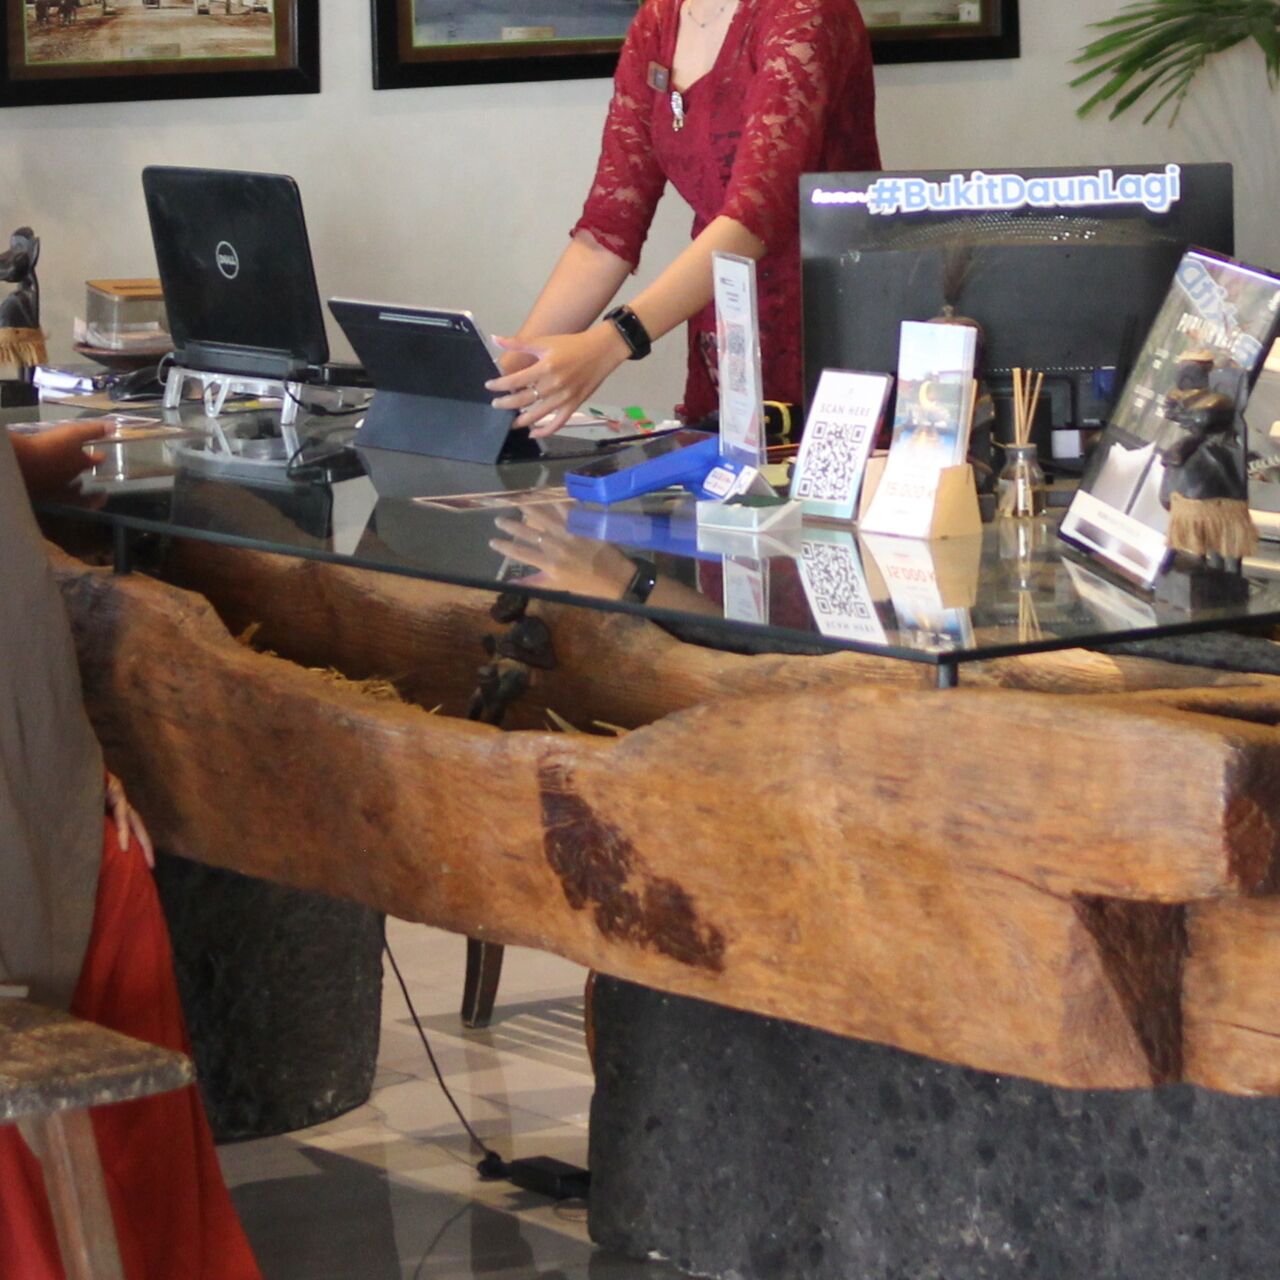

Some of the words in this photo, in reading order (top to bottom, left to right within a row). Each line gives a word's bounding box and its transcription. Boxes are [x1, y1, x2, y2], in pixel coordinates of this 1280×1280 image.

[868, 163, 1181, 214] #BukitDaunLagi
[820, 402, 845, 415] SCAN
[847, 405, 871, 417] HERE
